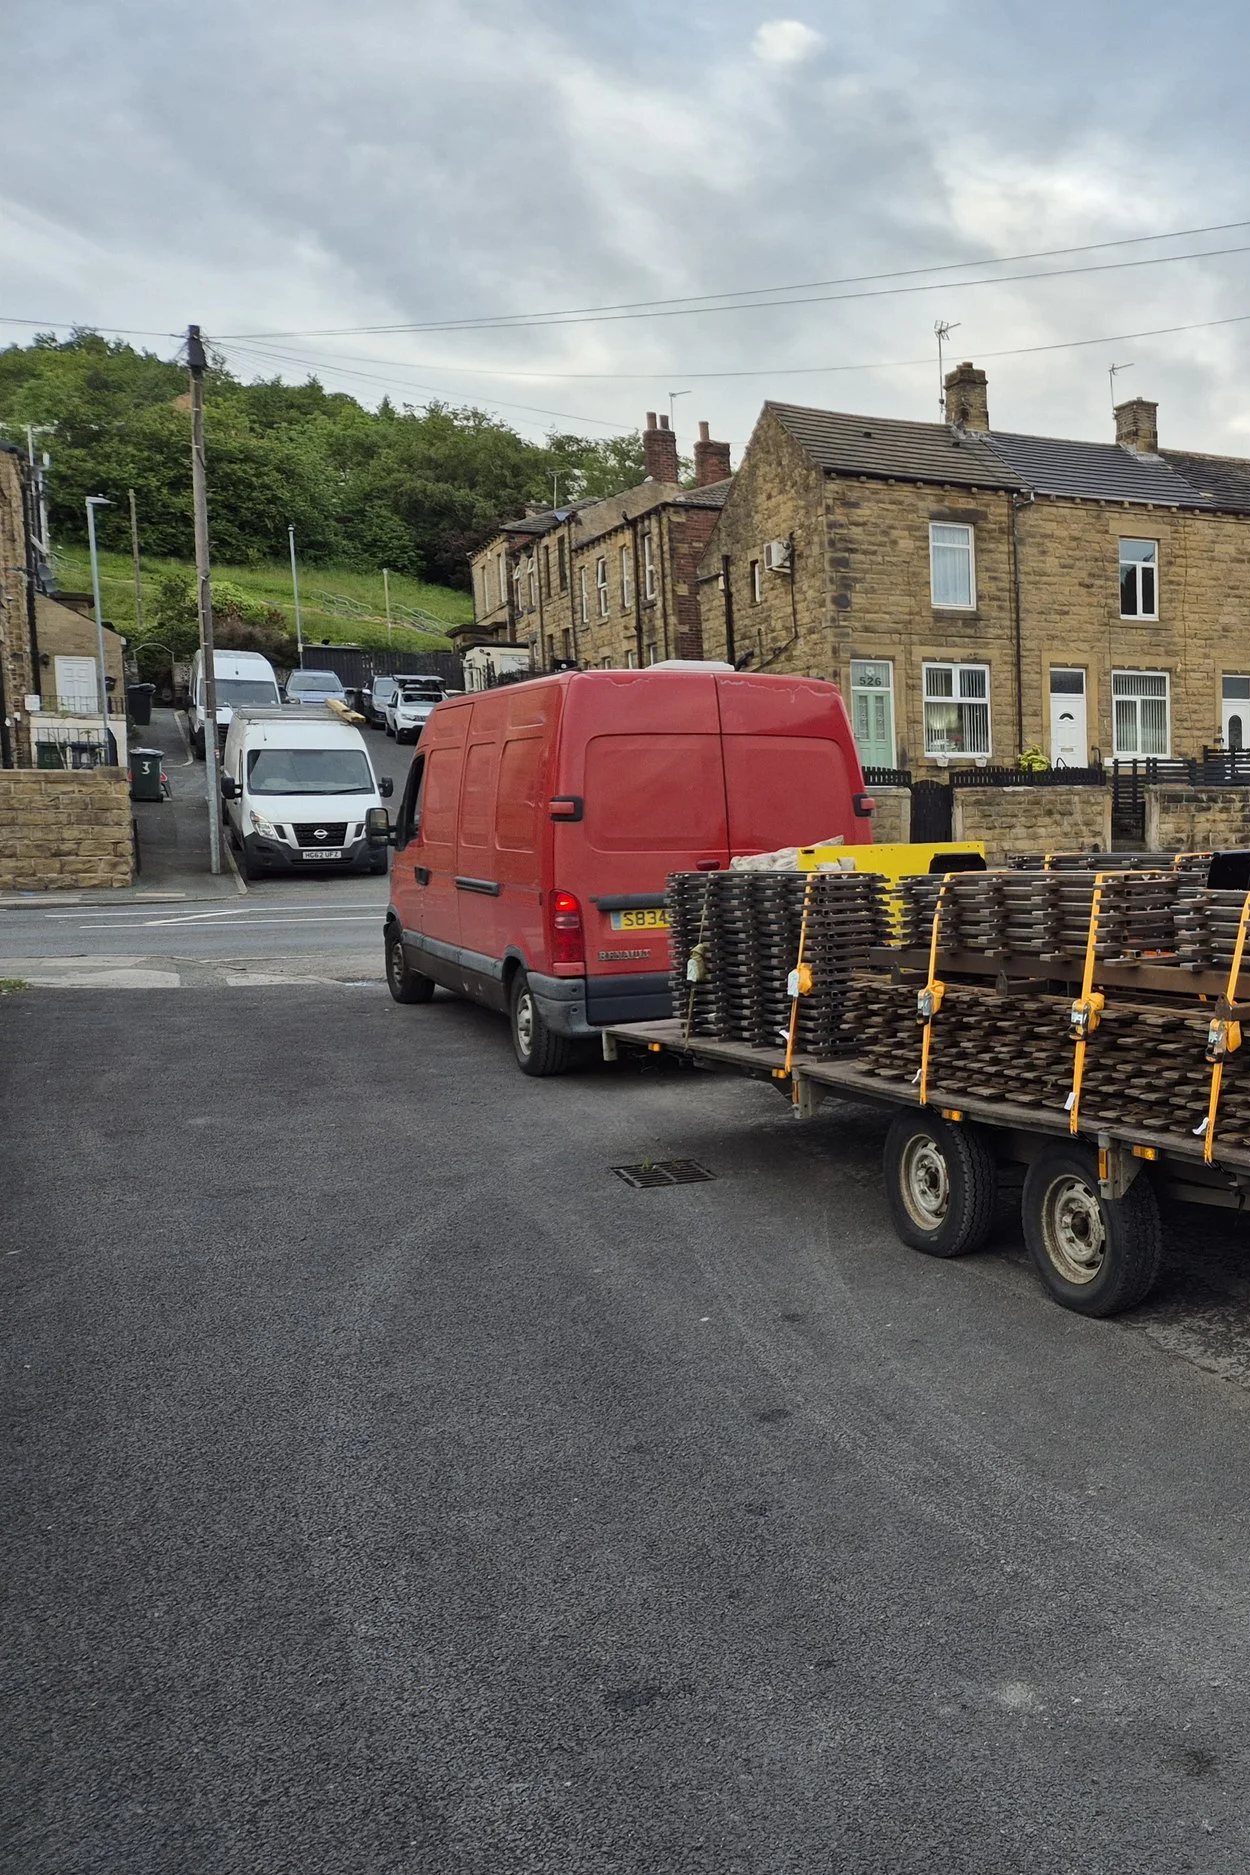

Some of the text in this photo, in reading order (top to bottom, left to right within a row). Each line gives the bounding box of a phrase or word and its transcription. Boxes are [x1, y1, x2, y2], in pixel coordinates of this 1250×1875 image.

[859, 676, 882, 686] 526
[141, 761, 152, 775] 3
[623, 910, 667, 927] S834
[598, 949, 651, 961] RENAULT
